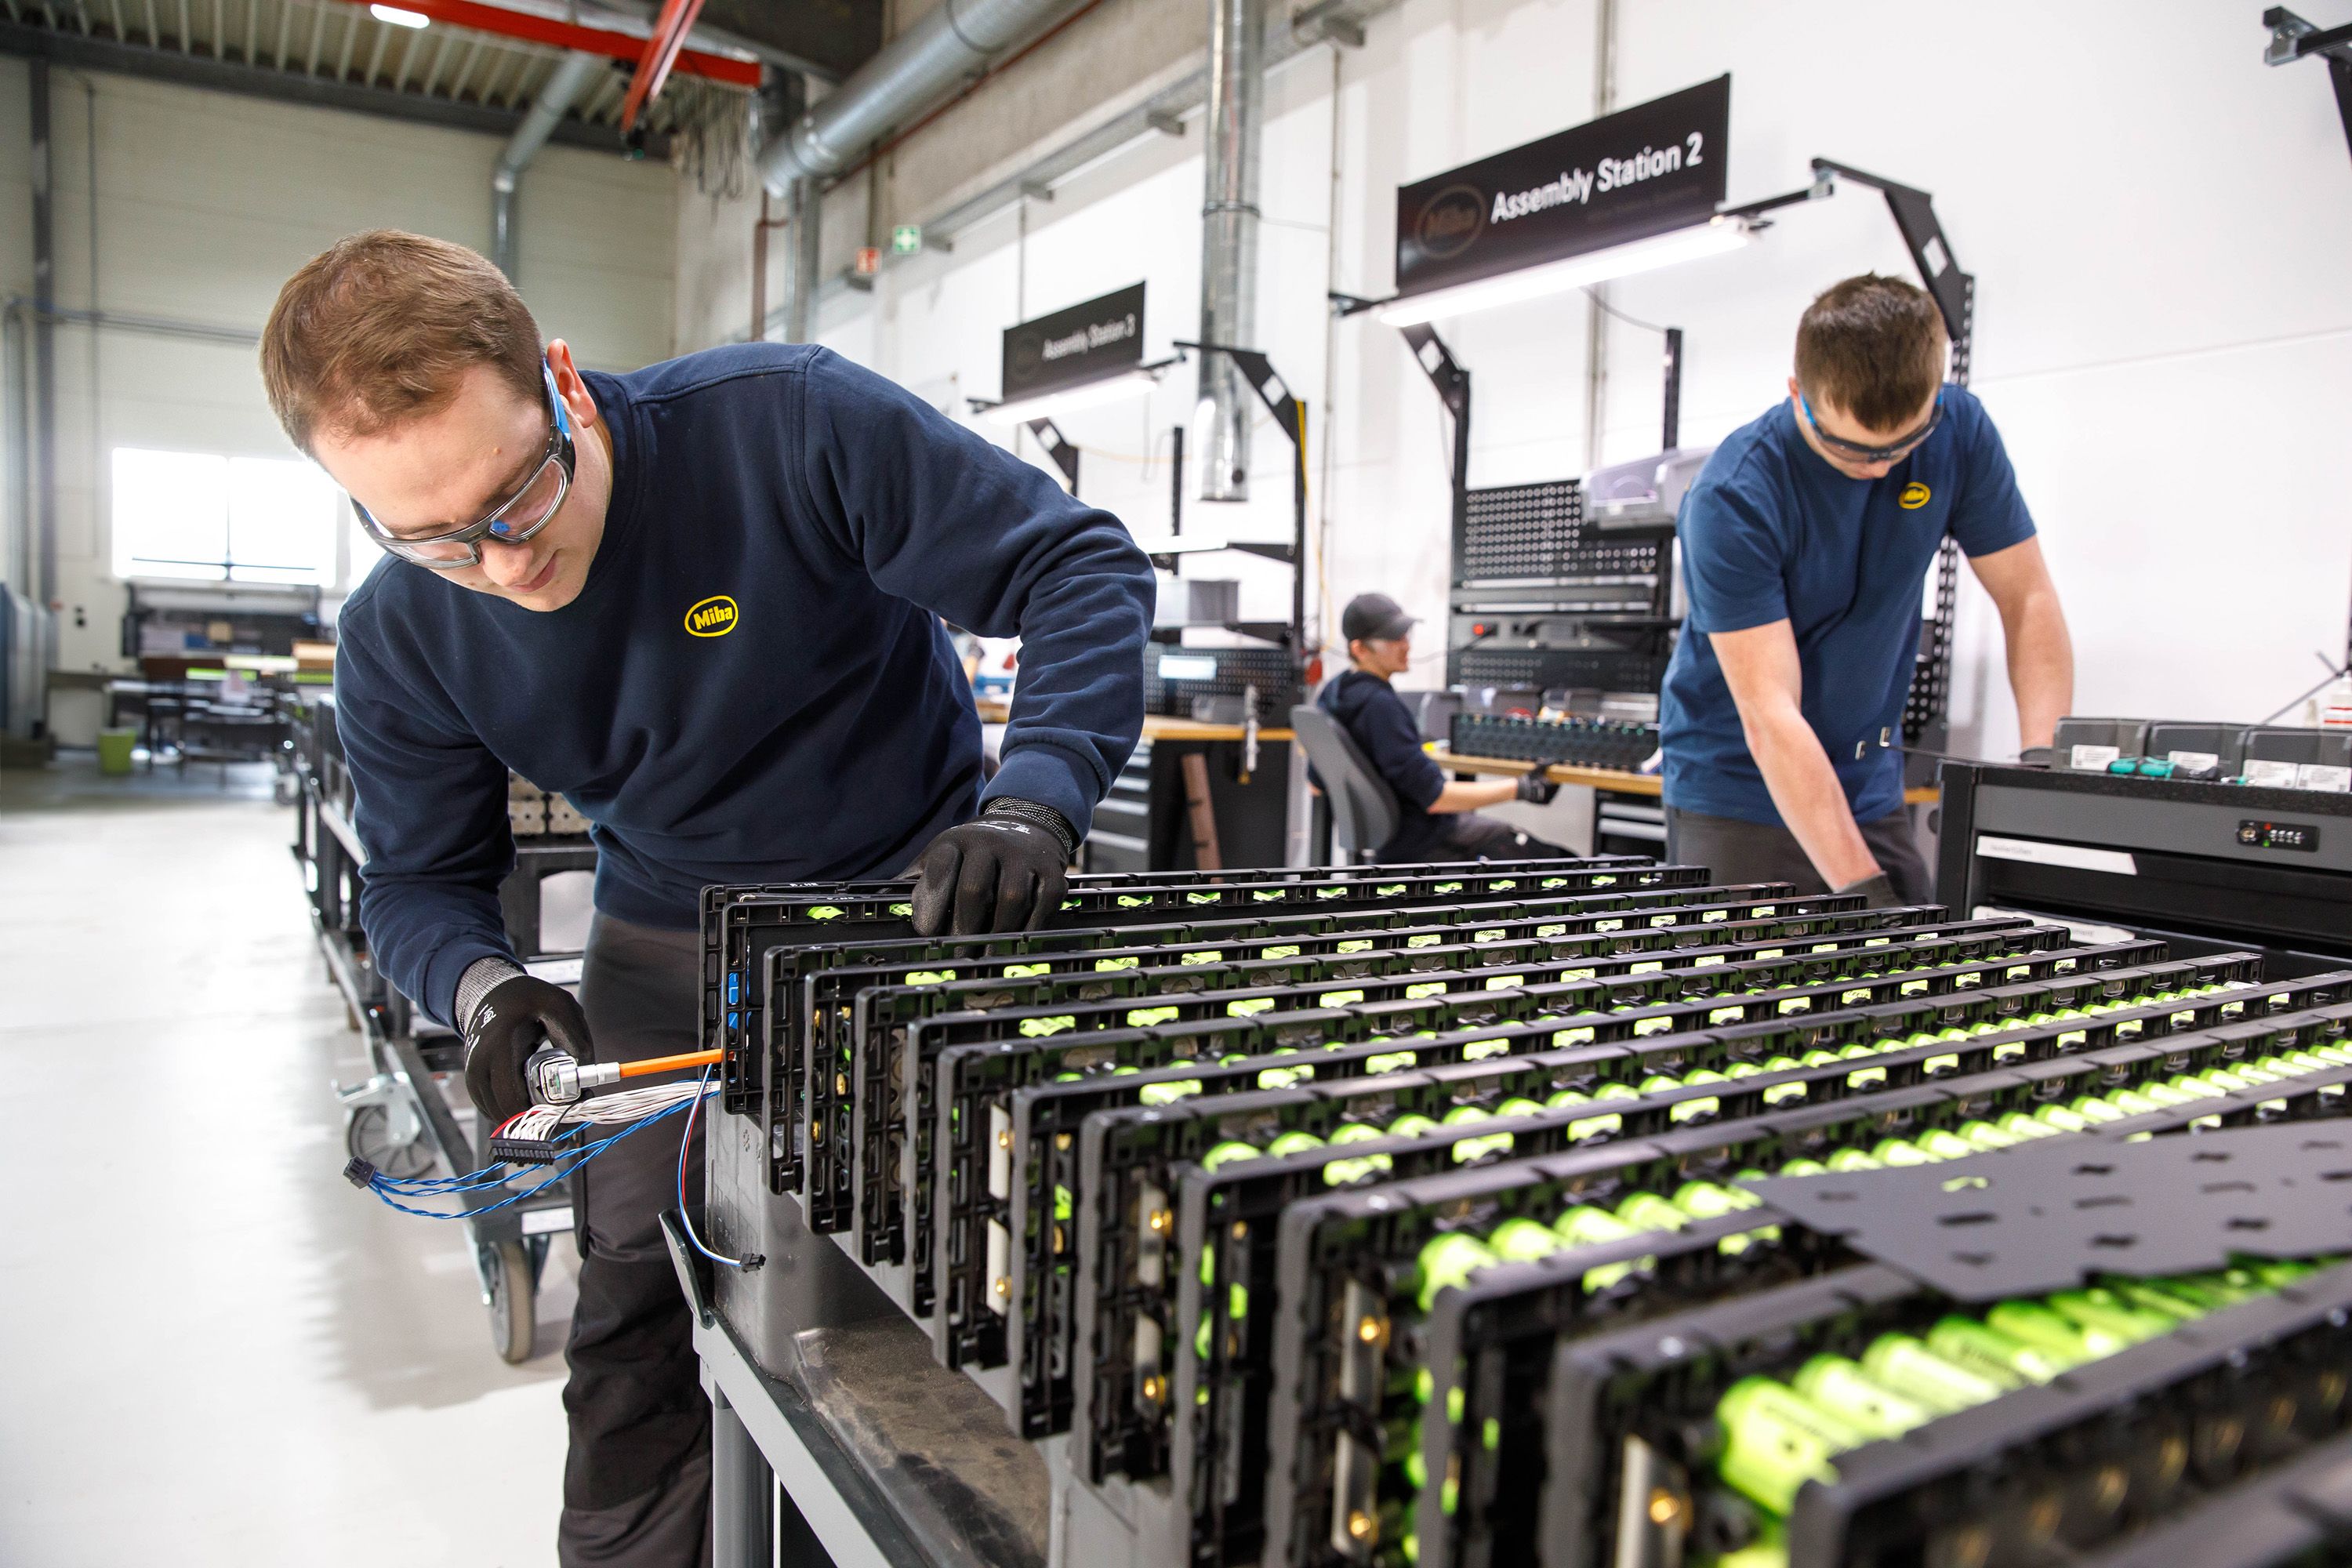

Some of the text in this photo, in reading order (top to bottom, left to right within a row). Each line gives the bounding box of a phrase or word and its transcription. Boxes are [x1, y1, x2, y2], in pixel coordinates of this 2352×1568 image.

[1490, 168, 1594, 224] Assembly
[1597, 145, 1681, 193] Station
[1686, 131, 1704, 166] 2
[693, 605, 733, 630] Miba
